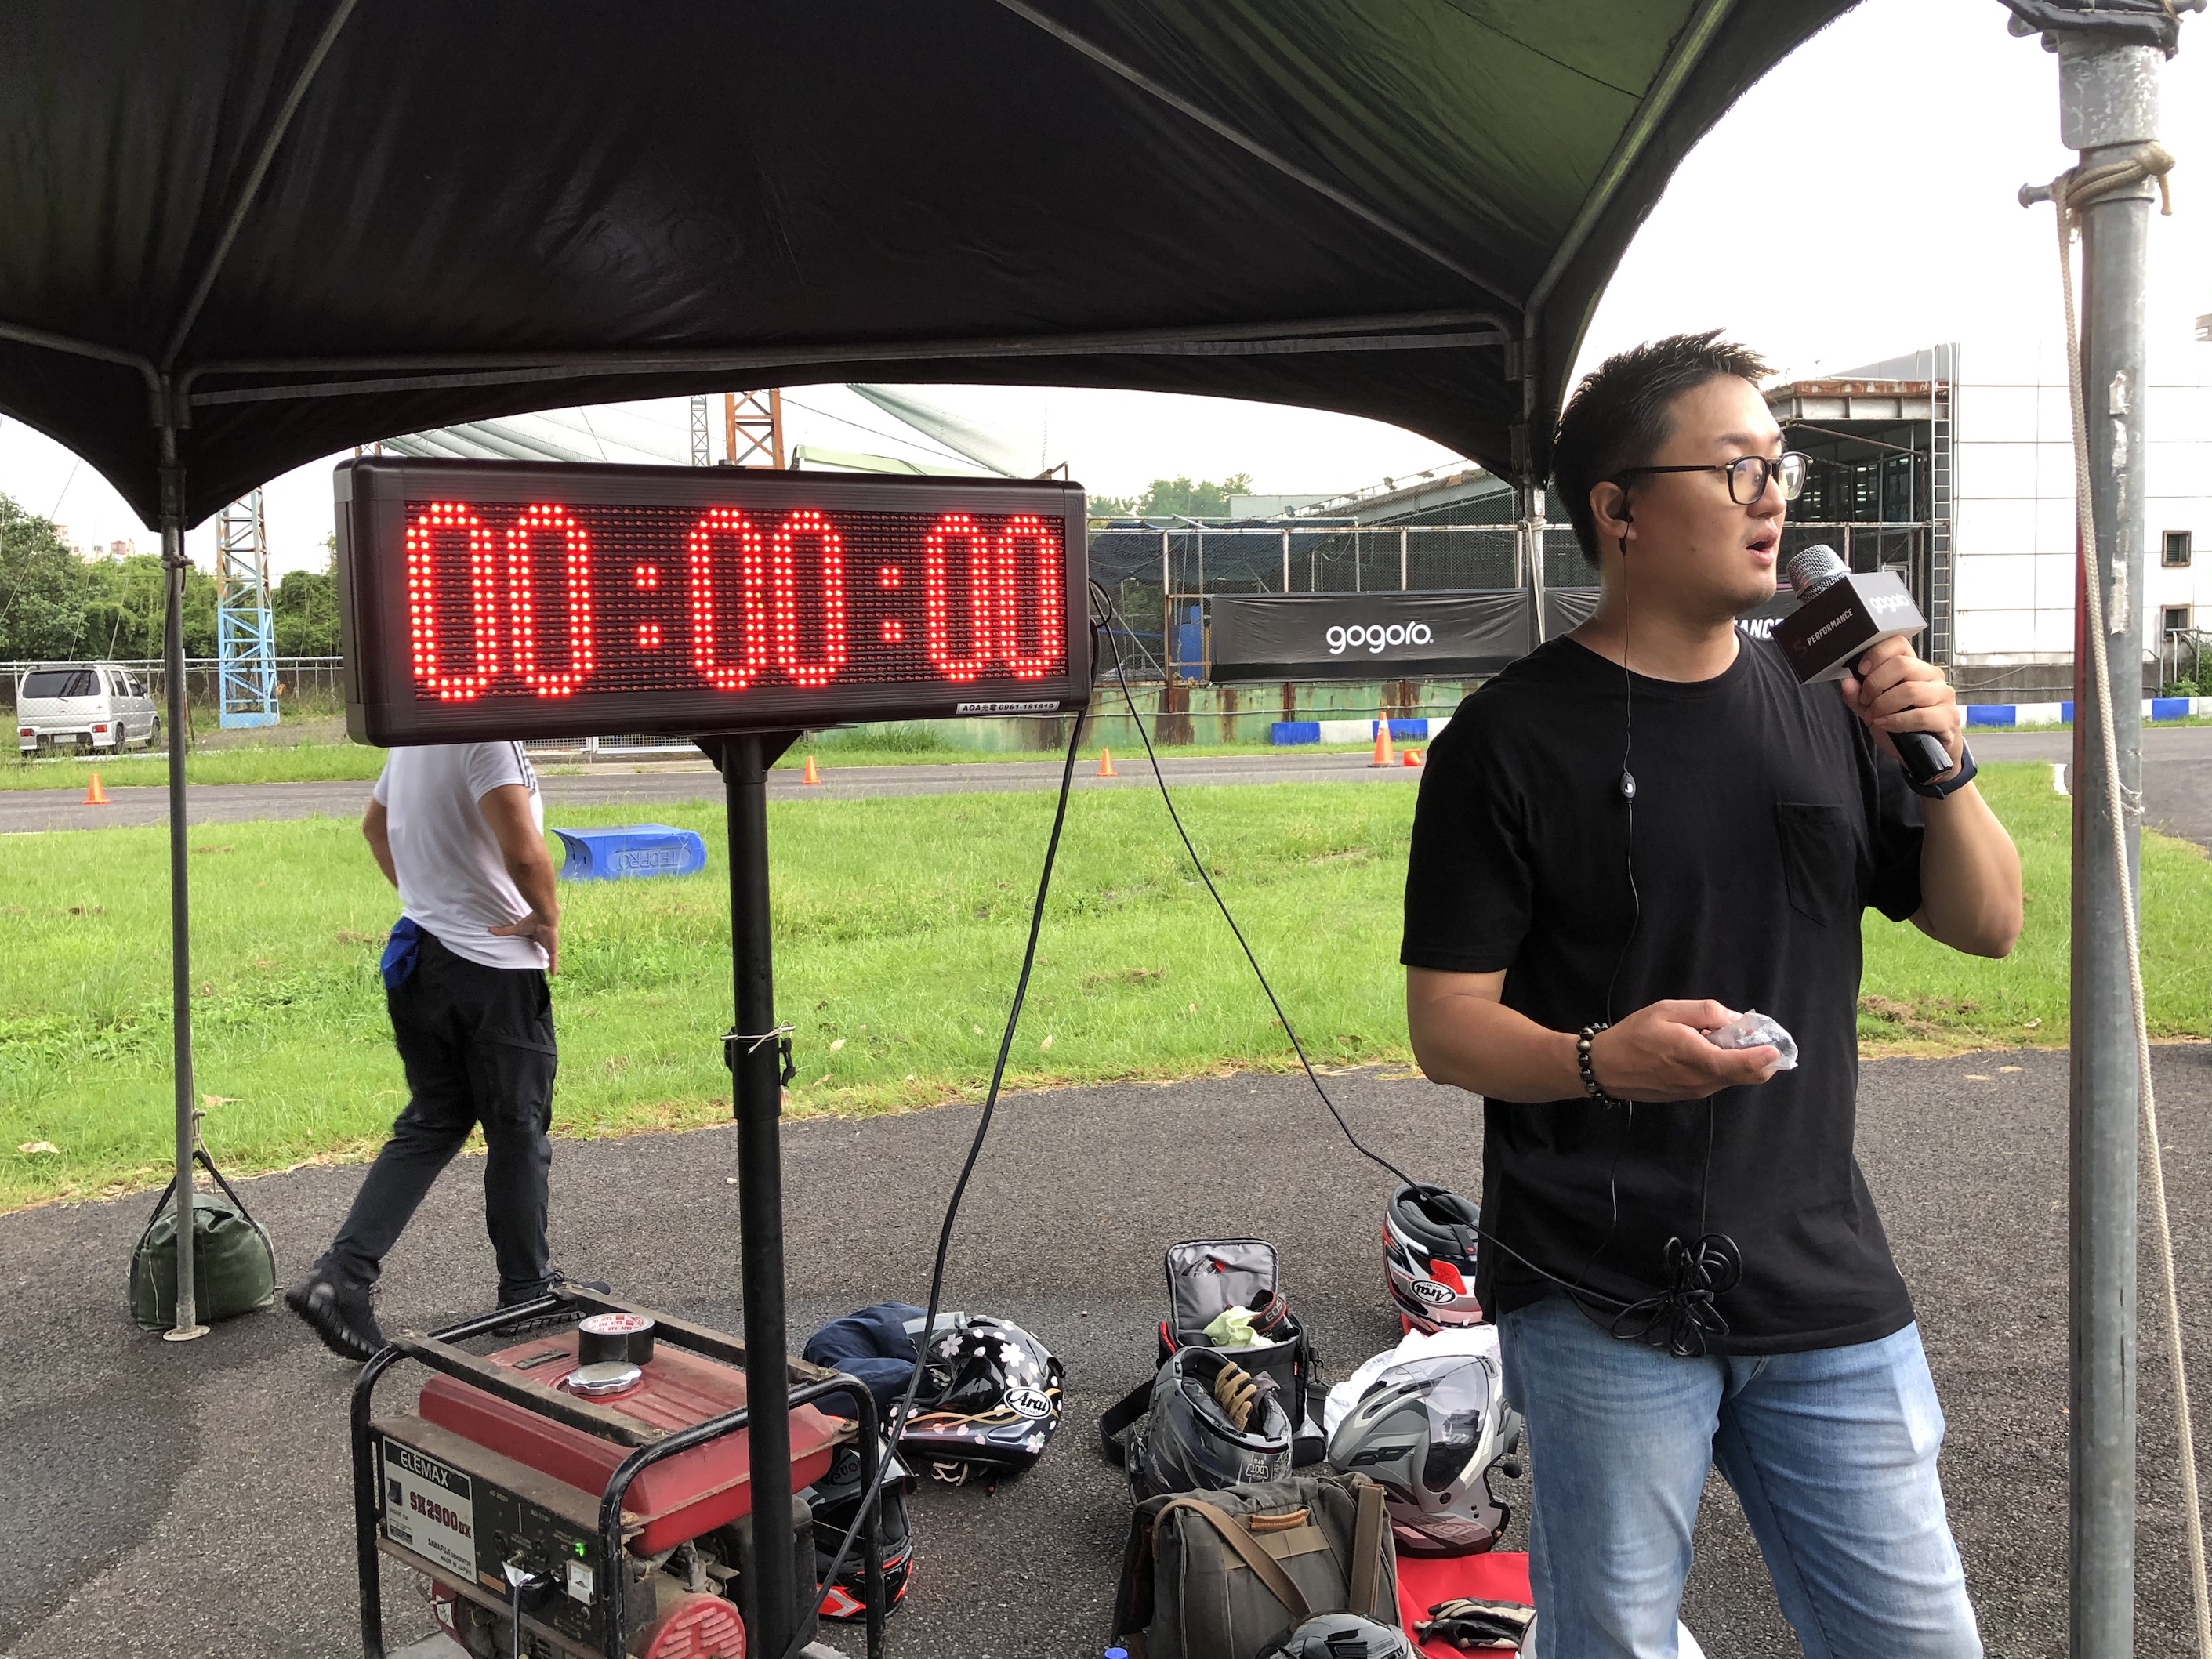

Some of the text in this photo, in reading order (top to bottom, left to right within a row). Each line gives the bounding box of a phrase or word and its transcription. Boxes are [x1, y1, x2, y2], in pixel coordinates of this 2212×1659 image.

[1806, 607, 1854, 647] PERFORMANCE
[618, 849, 680, 868] TECPRO
[1416, 1285, 1452, 1302] Arai
[1266, 1299, 1283, 1322] EOS
[1008, 1391, 1049, 1412] Arai
[400, 1450, 448, 1487] ELEMAX
[1250, 1464, 1265, 1475] DOT
